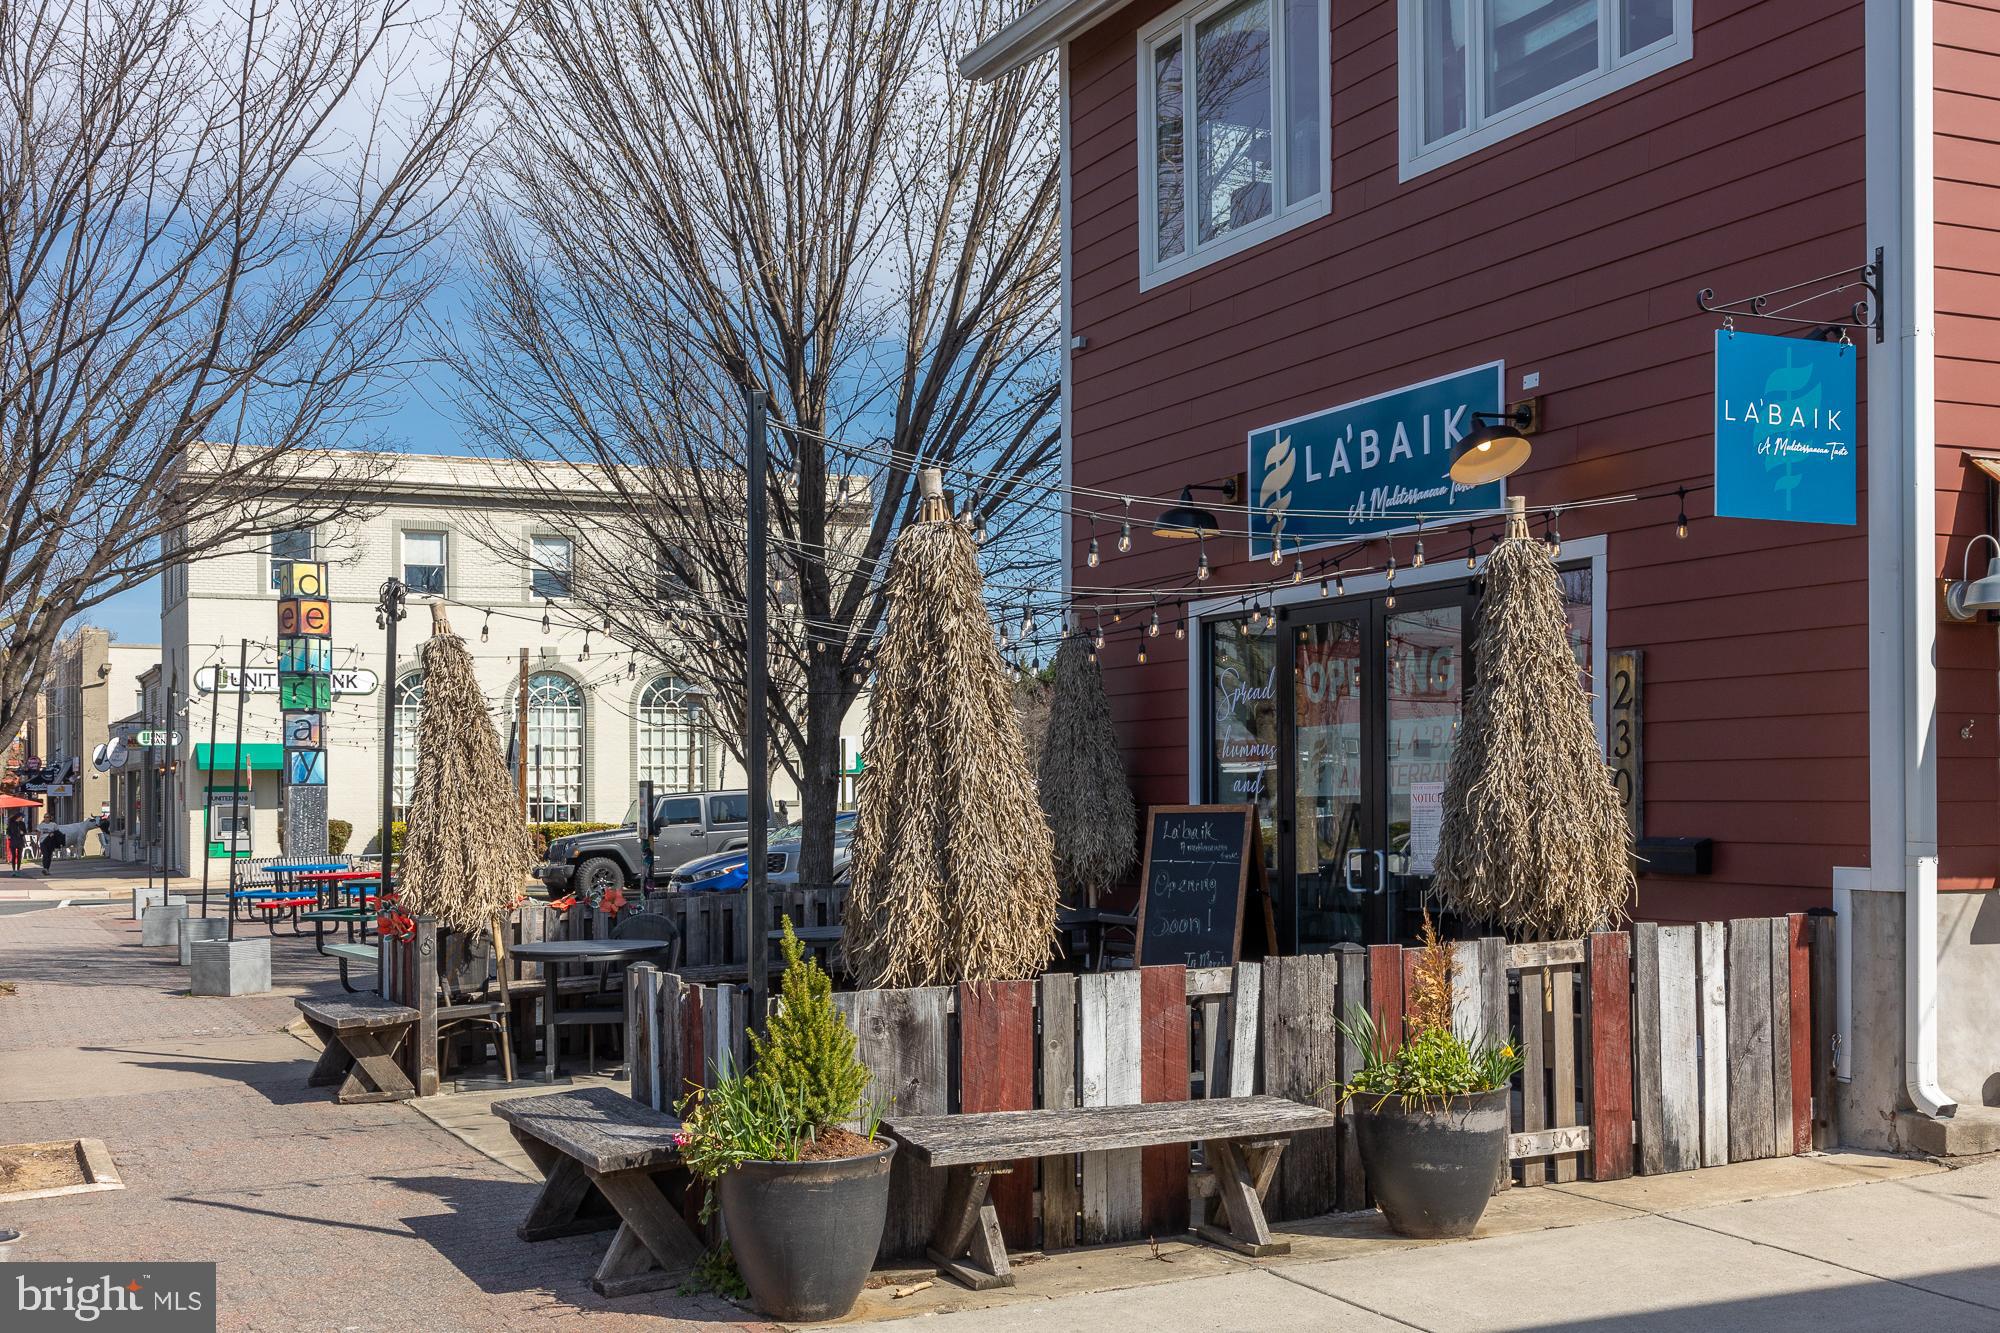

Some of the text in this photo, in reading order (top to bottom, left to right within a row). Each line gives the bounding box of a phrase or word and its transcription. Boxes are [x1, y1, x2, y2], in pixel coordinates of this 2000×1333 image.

[1725, 398, 1841, 431] LA'BAIK
[1305, 404, 1468, 483] LA'BAIK
[1757, 437, 1849, 461] A Mediterranean Taste
[1348, 491, 1366, 525] A
[1369, 485, 1449, 521] Mediterranean
[1216, 665, 1277, 721] Spread
[1222, 725, 1278, 760] hummus
[1233, 761, 1265, 794] and
